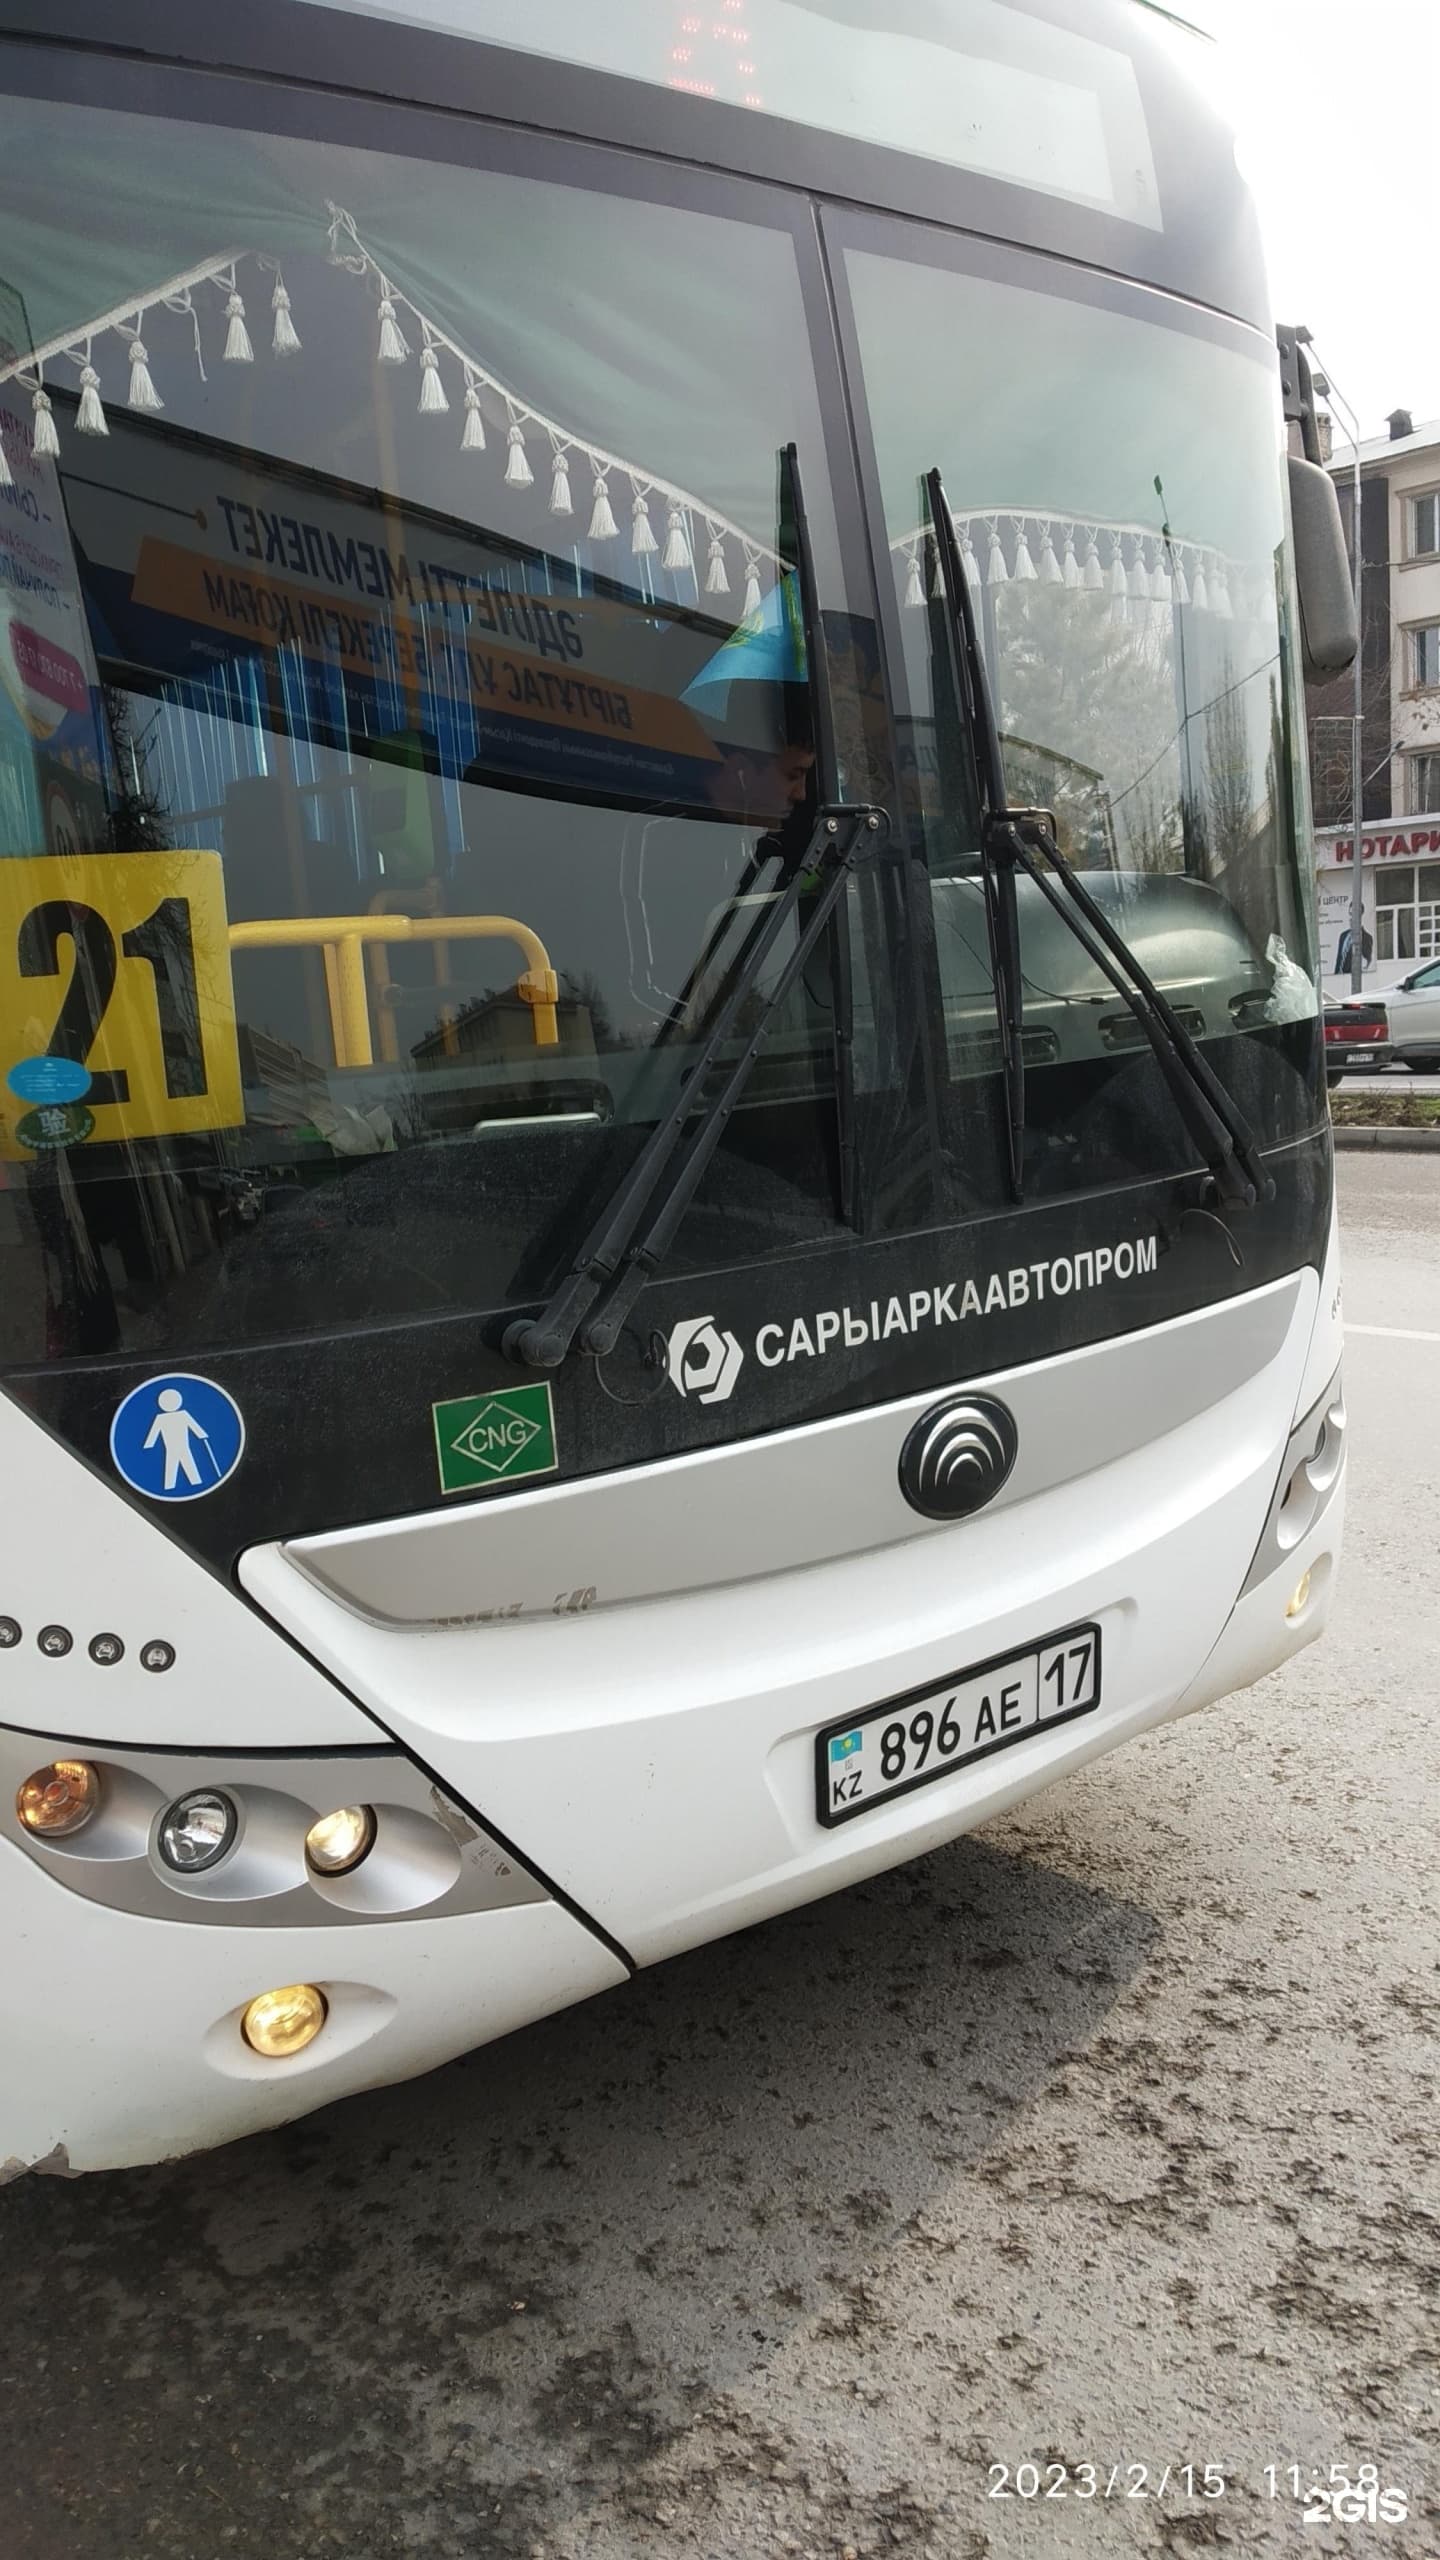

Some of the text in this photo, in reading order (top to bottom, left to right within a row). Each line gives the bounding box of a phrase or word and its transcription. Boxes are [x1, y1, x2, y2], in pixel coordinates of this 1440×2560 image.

[1322, 895, 1349, 905] ЦЕНТР
[18, 897, 208, 1105] 21
[755, 1236, 1158, 1368] САРЫАРКААВТОПРОМ
[468, 1419, 528, 1450] CNG
[880, 1642, 1092, 1781] 896 AE 17
[833, 1770, 863, 1806] KZ
